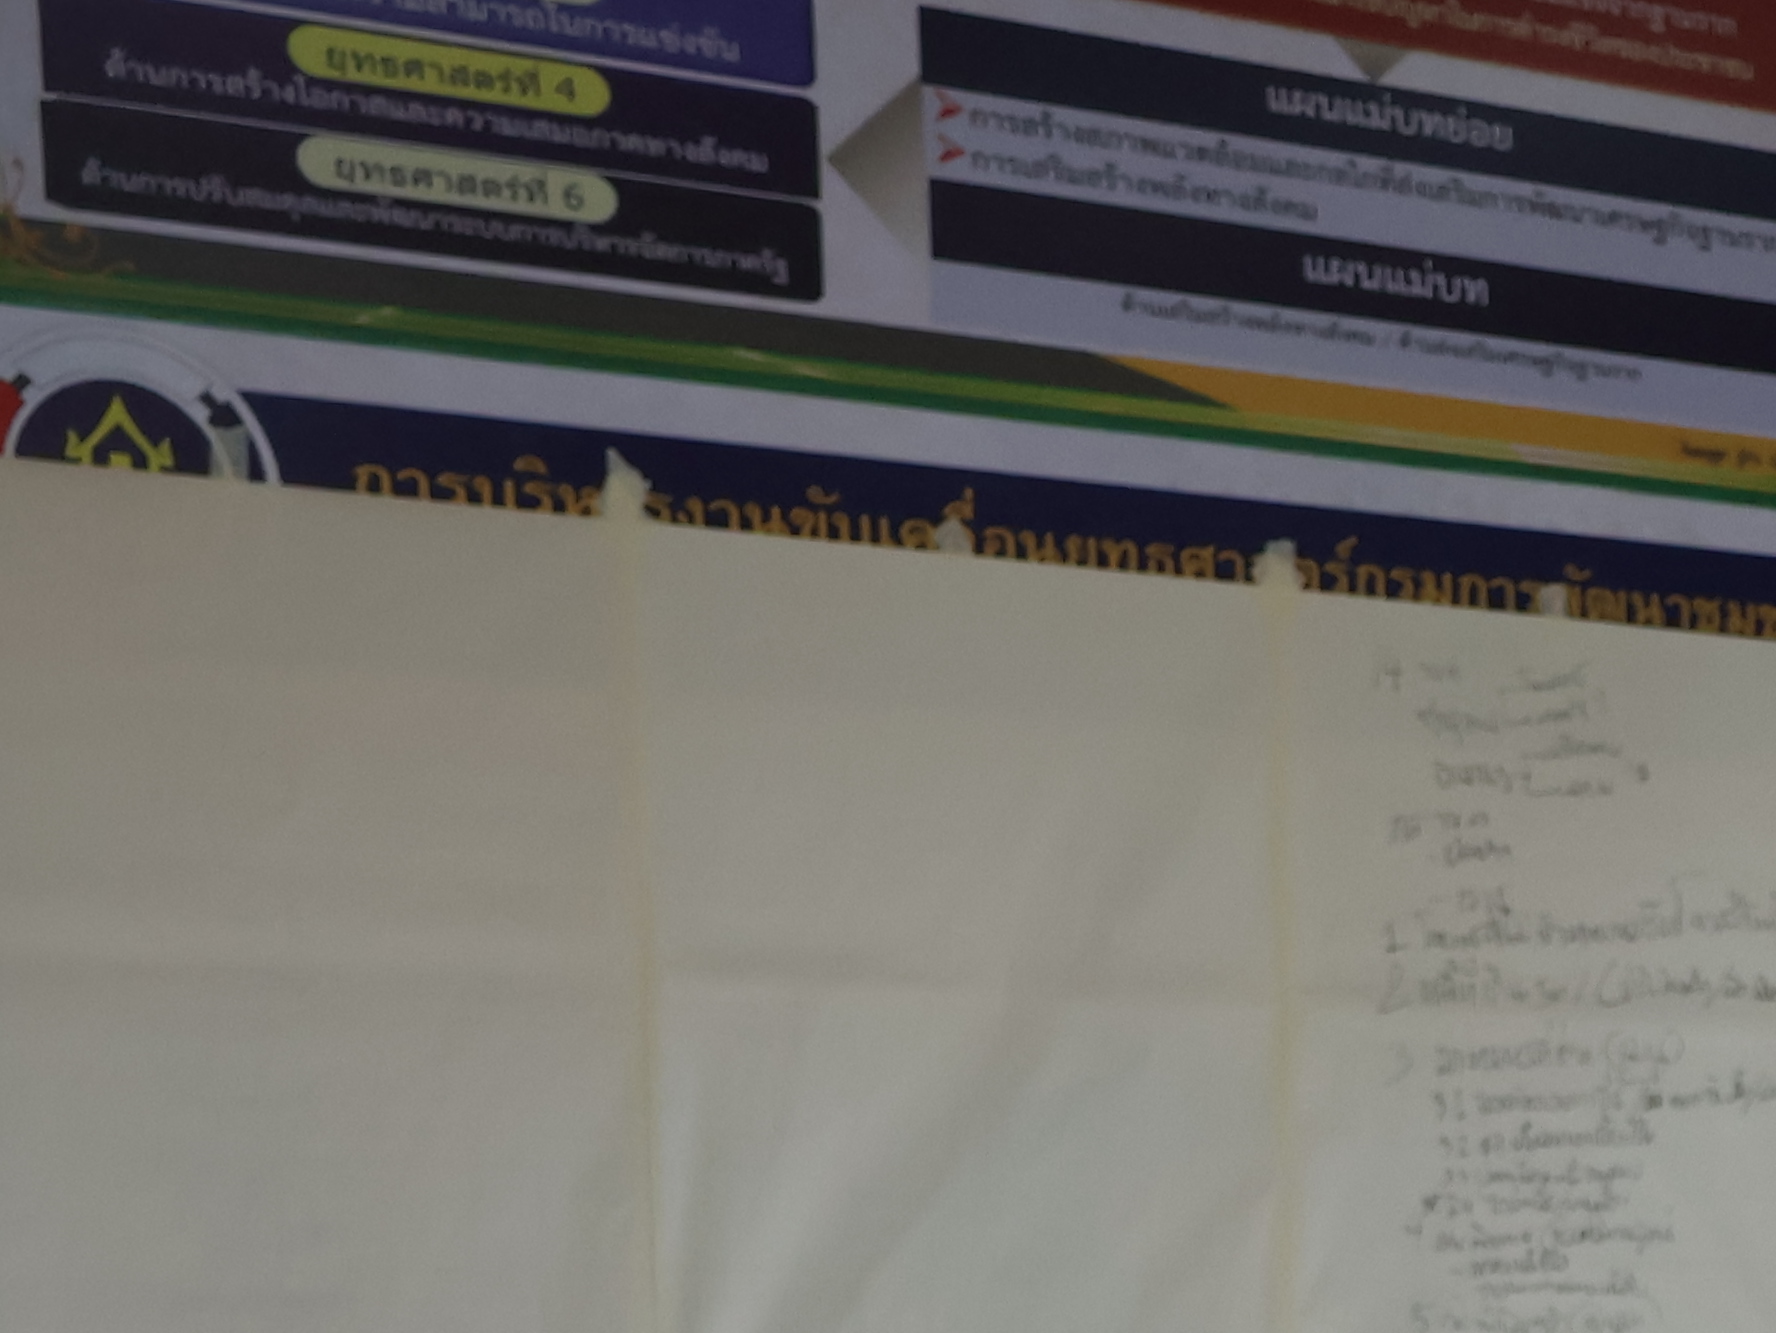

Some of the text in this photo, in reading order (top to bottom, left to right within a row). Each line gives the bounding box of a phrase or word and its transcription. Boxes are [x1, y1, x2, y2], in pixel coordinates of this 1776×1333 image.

[555, 77, 578, 102] 4
[1264, 80, 1516, 153] แผนแม่บทย่อย
[562, 182, 585, 212] 6
[1302, 248, 1490, 308] แผนแม่บท
